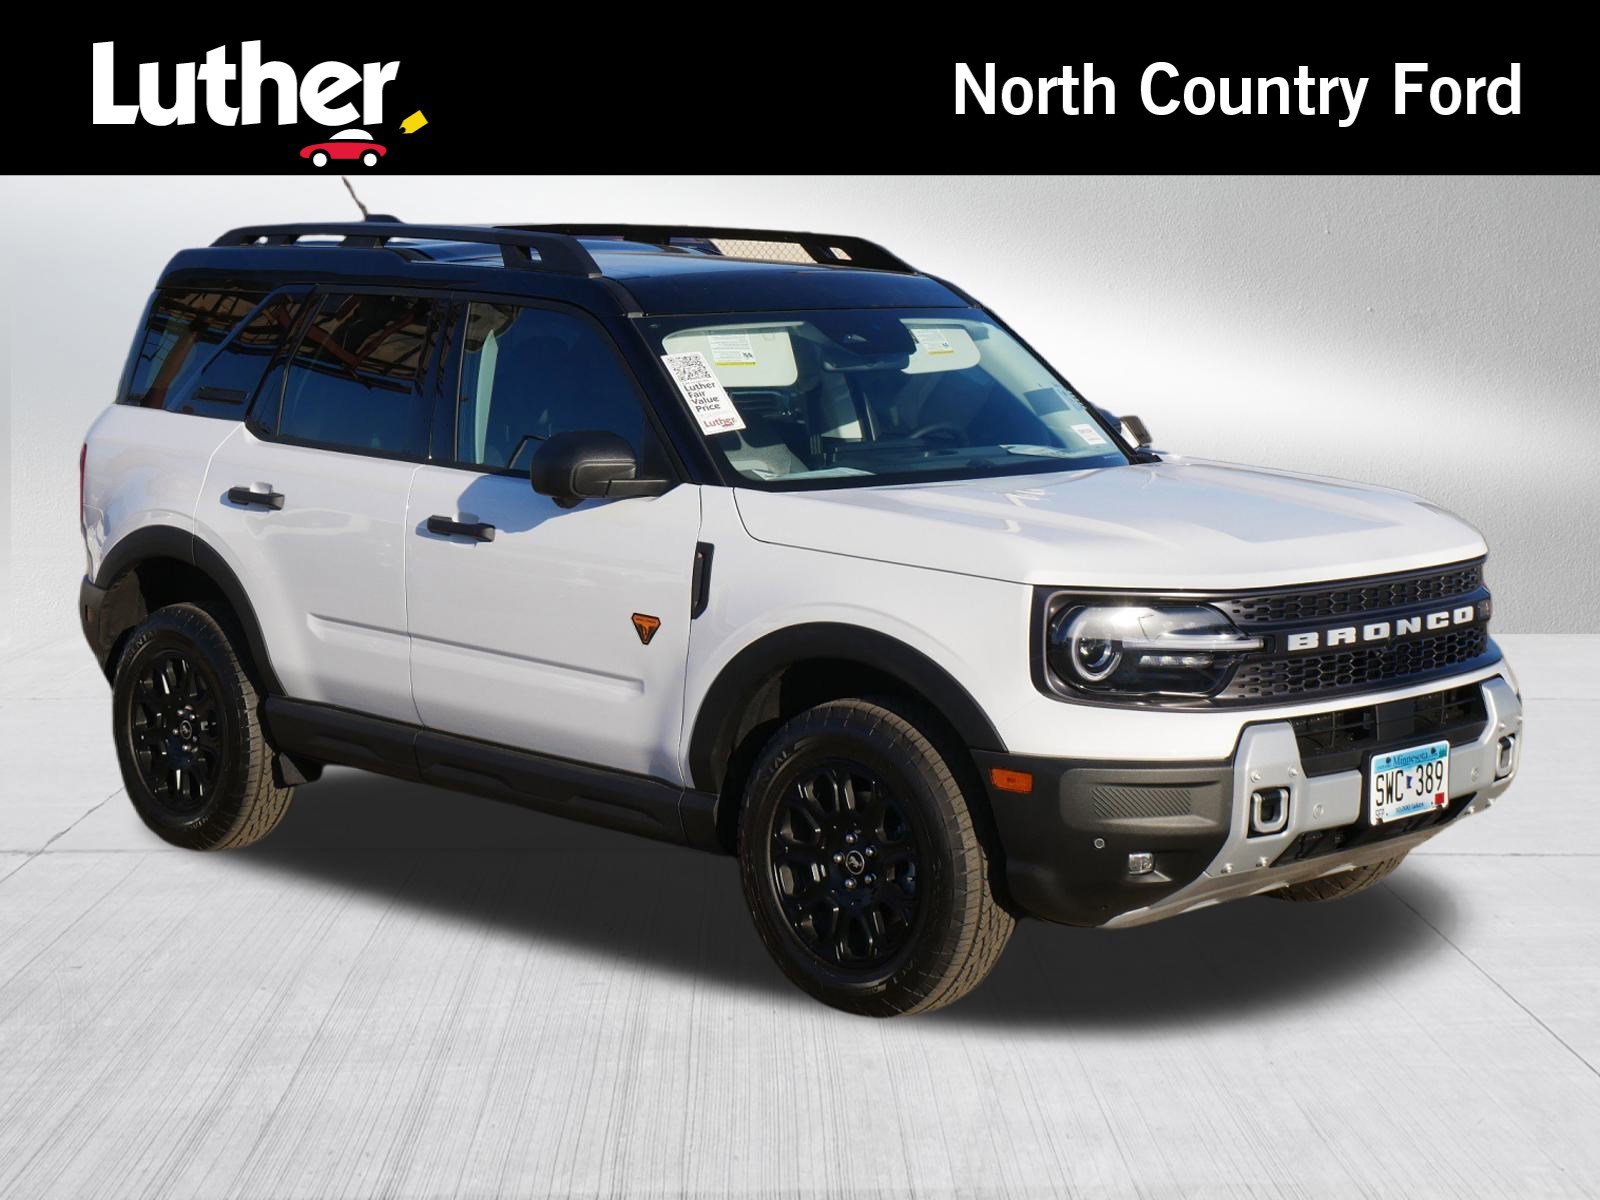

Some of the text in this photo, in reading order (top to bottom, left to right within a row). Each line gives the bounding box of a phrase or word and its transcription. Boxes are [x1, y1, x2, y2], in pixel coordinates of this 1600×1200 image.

[684, 382, 716, 392] Luther
[688, 390, 706, 399] Fair
[691, 396, 720, 405] Value
[695, 403, 721, 413] Price
[703, 417, 735, 428] Luther
[1288, 605, 1474, 651] BRONCO
[1392, 751, 1428, 766] Minnesota
[1375, 760, 1444, 807] SWC 389
